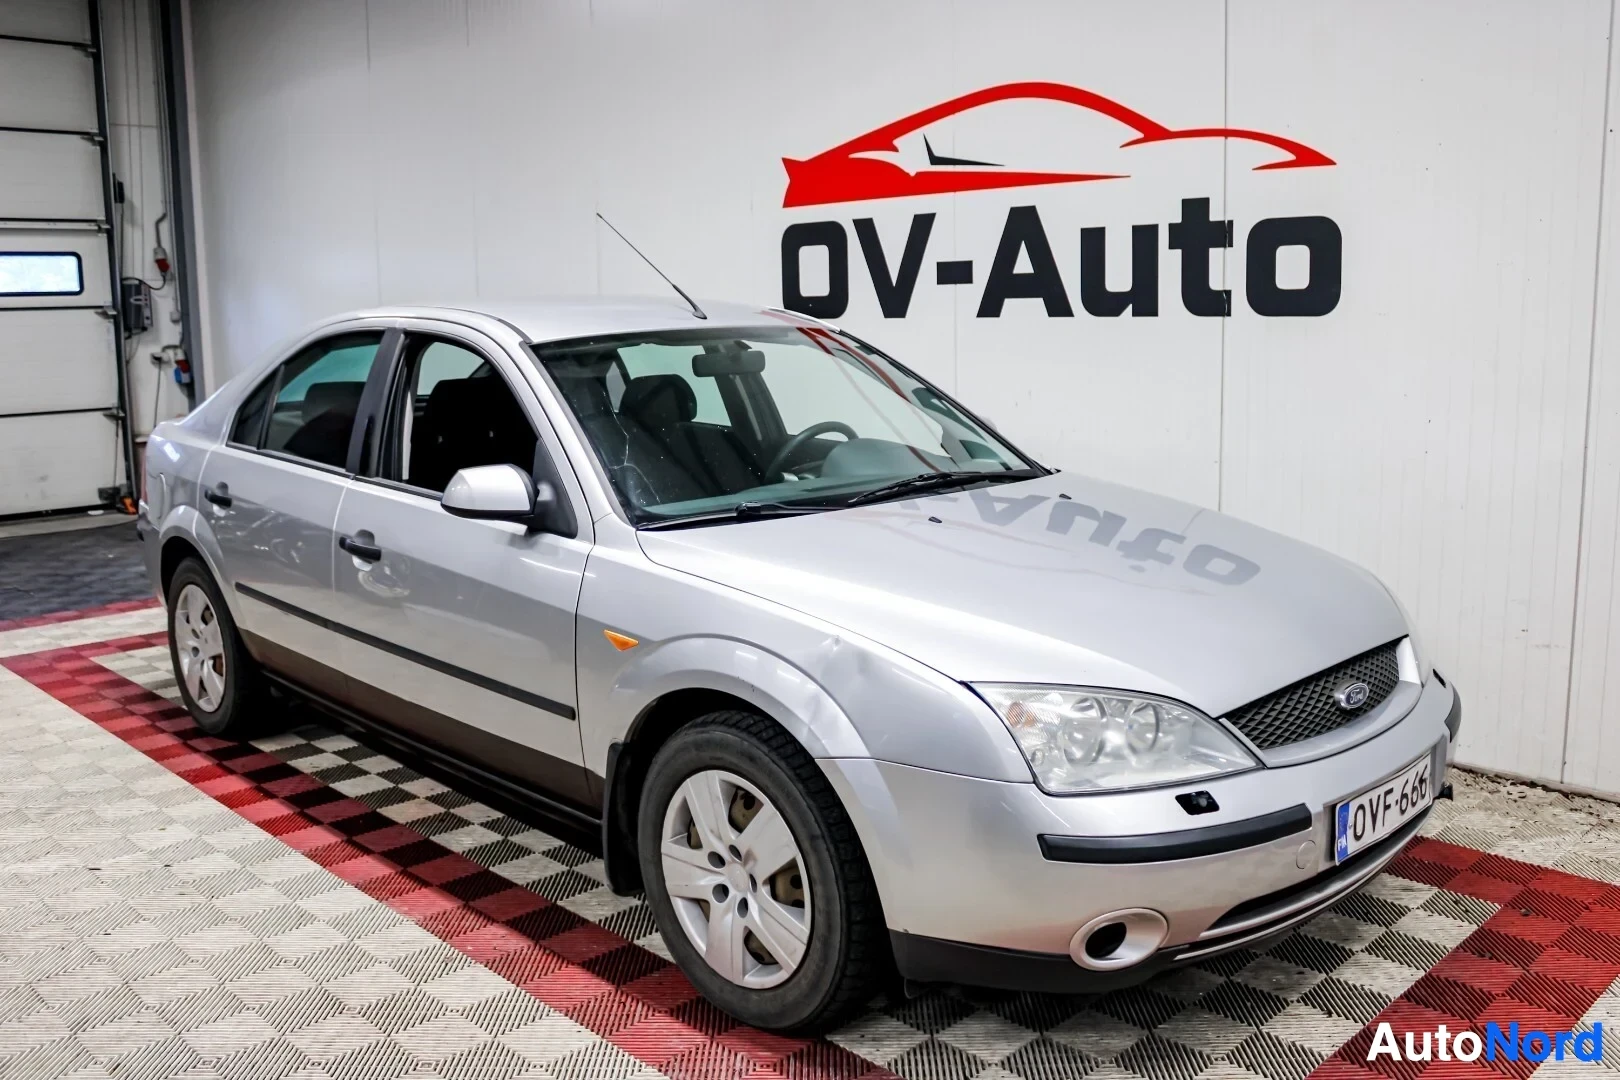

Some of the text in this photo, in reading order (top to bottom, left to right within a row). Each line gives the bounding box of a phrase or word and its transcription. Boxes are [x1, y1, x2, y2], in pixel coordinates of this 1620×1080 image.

[782, 197, 1343, 319] OV-Auto
[1353, 764, 1428, 841] OVF-666
[1337, 834, 1347, 851] FIN
